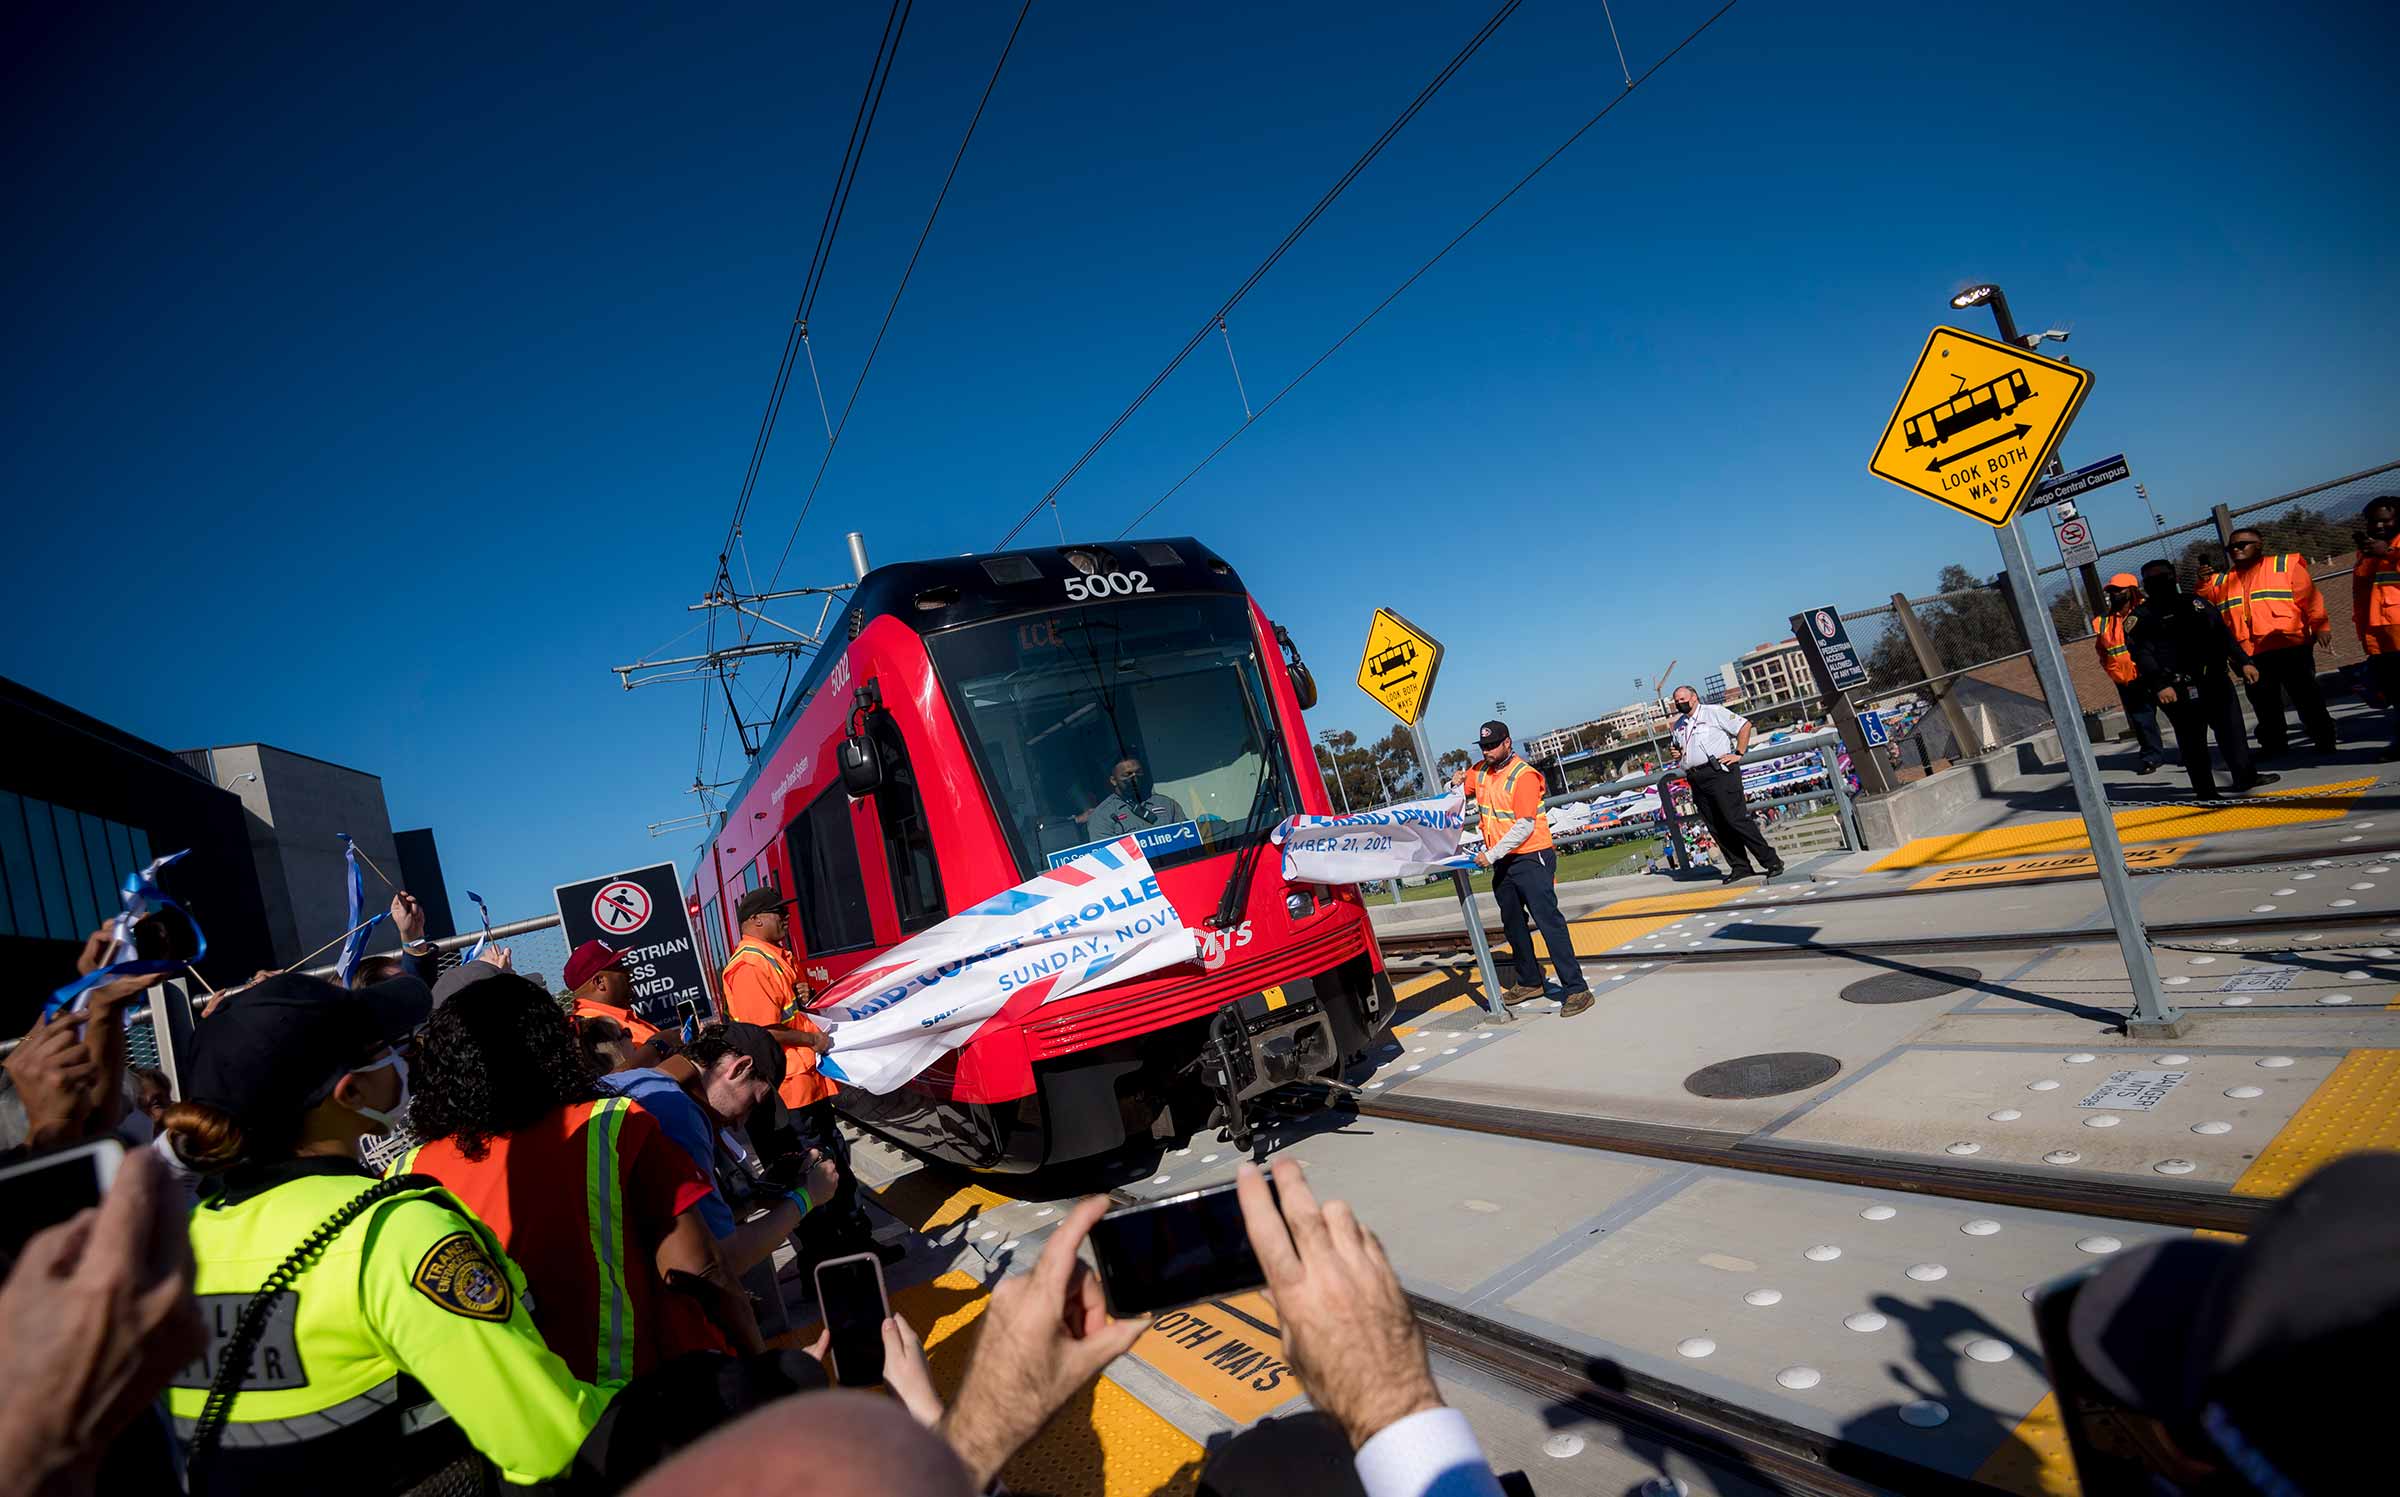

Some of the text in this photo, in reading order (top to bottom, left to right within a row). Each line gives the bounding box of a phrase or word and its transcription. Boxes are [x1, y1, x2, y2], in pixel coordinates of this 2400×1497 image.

[1941, 446, 2028, 491] LOOK BOTH
[2054, 479, 2087, 497] Central
[2087, 465, 2127, 486] Campus
[1969, 474, 2011, 500] WAYS
[1064, 571, 1155, 601] 5002
[1817, 639, 1828, 648] NO
[830, 651, 850, 697] 5002
[1385, 683, 1418, 703] LOOK BOTH
[1397, 697, 1413, 710] WAYS
[1149, 833, 1173, 847] Line
[1341, 838, 1359, 853] 21,
[1363, 836, 1393, 851] 2021
[2122, 846, 2180, 858] LOO
[1196, 920, 1253, 957] MTS
[998, 936, 1109, 992] SUNDAY,
[658, 986, 701, 1009] TIME
[2117, 1080, 2152, 1098] MTS
[2133, 1073, 2185, 1107] DANGER
[1153, 1312, 1297, 1392] OTH WAYS
